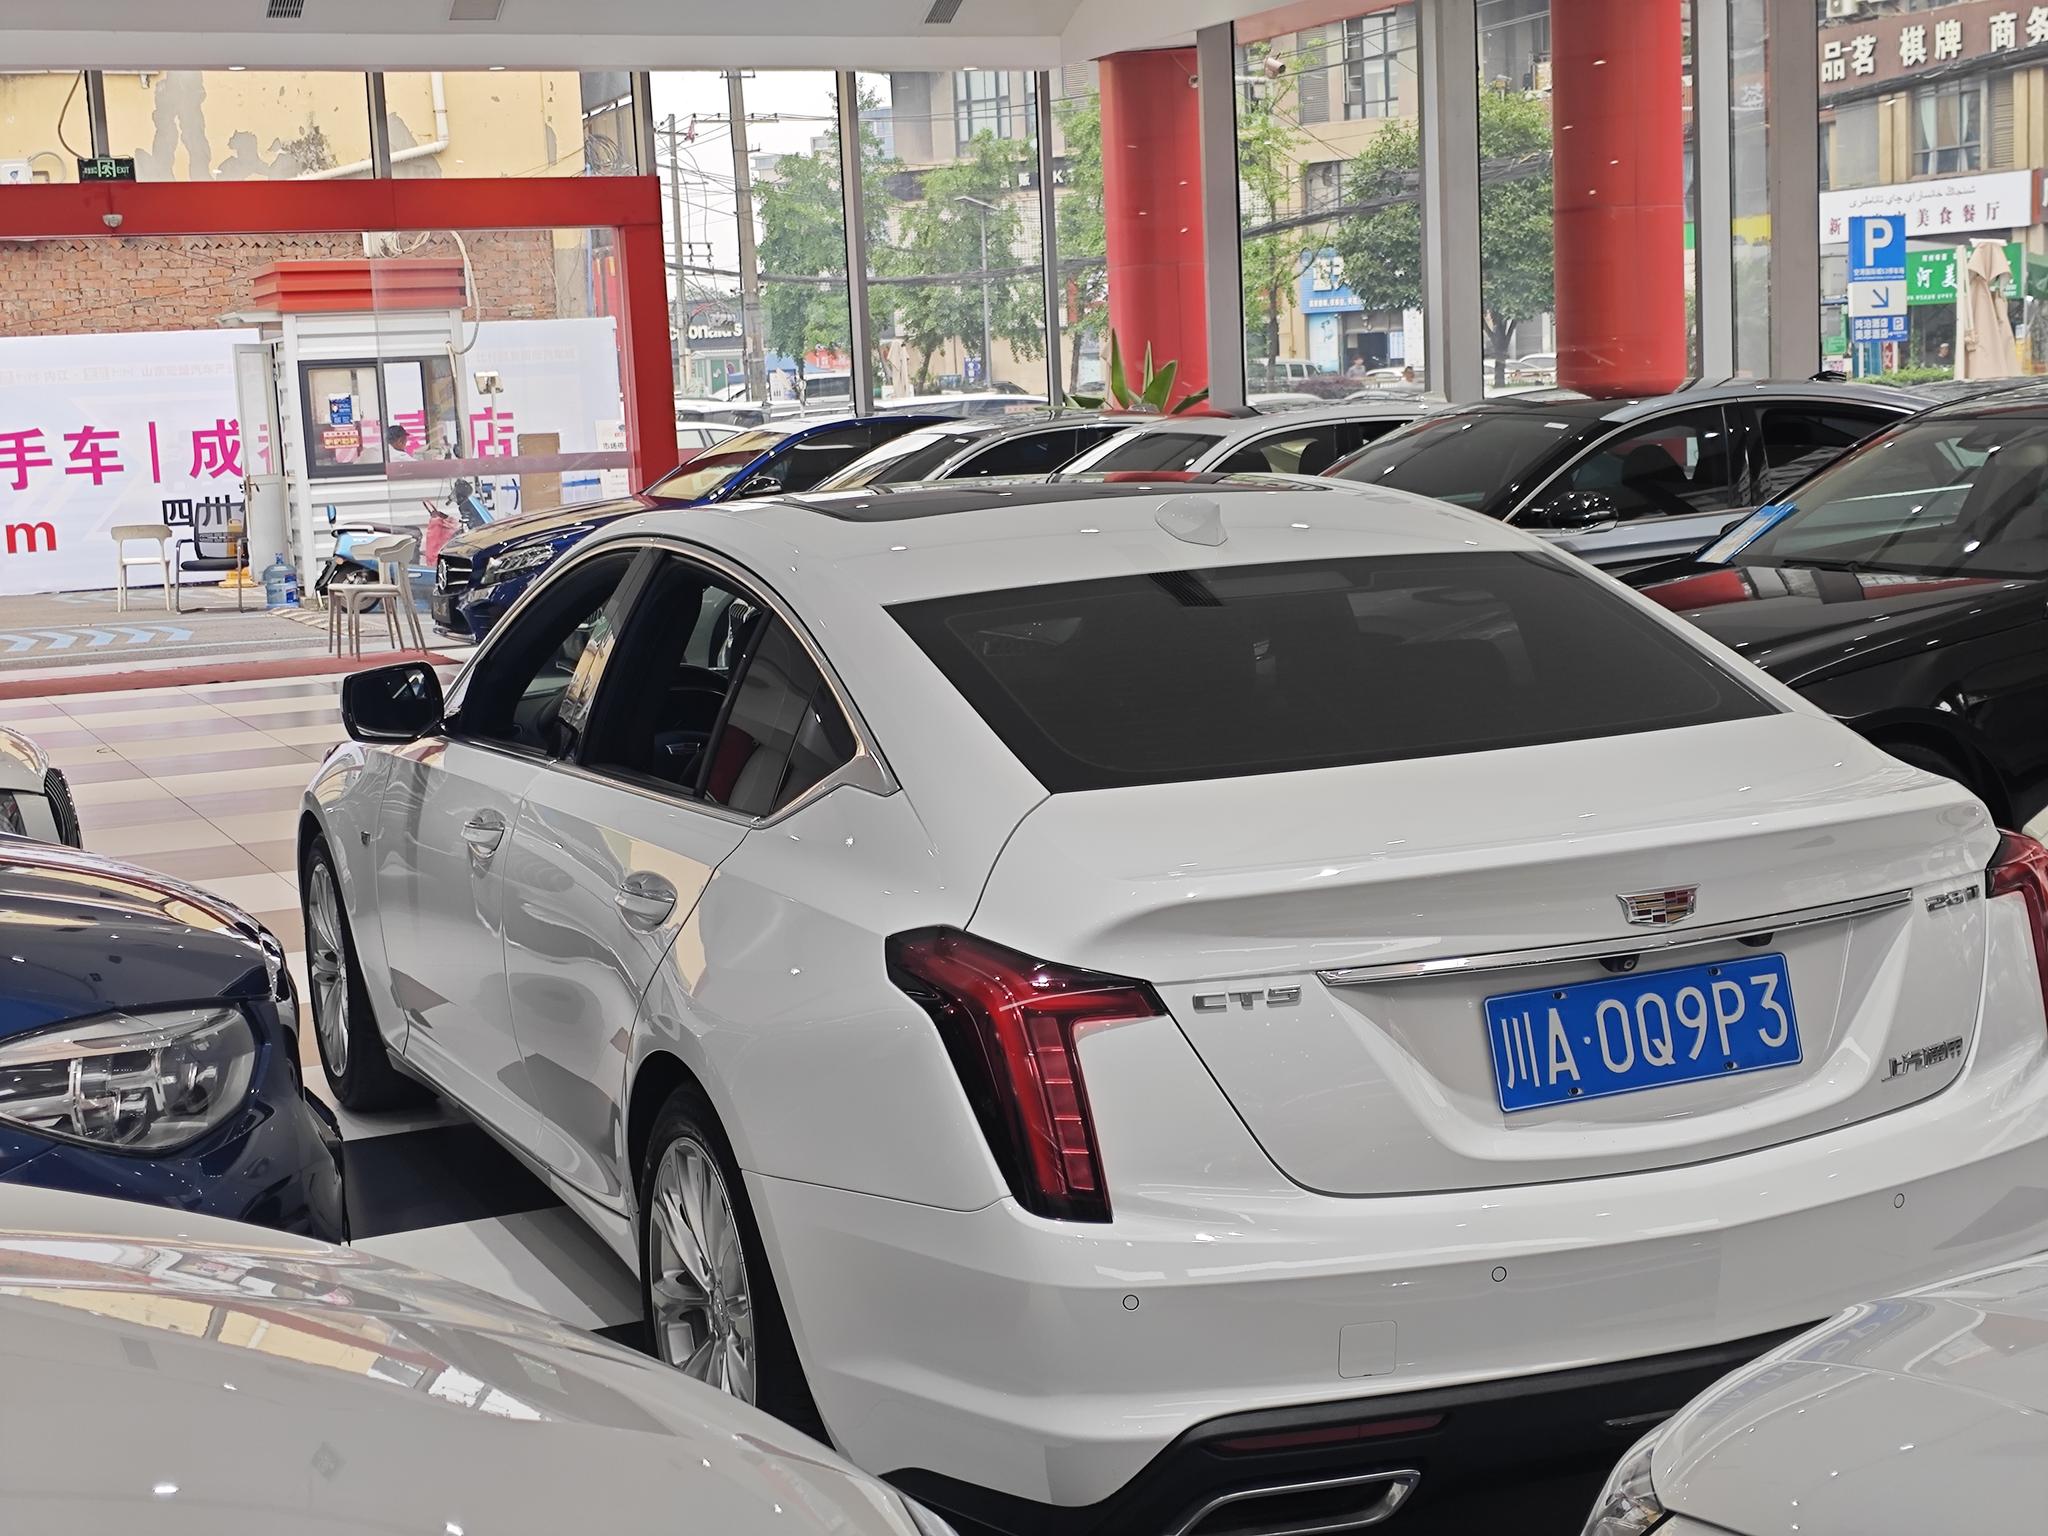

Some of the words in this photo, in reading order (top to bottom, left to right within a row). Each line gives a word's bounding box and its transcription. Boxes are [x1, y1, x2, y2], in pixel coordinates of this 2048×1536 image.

[1822, 34, 1877, 82] 品茗
[1900, 19, 1962, 67] 棋牌
[1829, 201, 2000, 236] 新美食餐厅
[1865, 219, 1894, 267] P
[1192, 984, 1301, 1014] CT5
